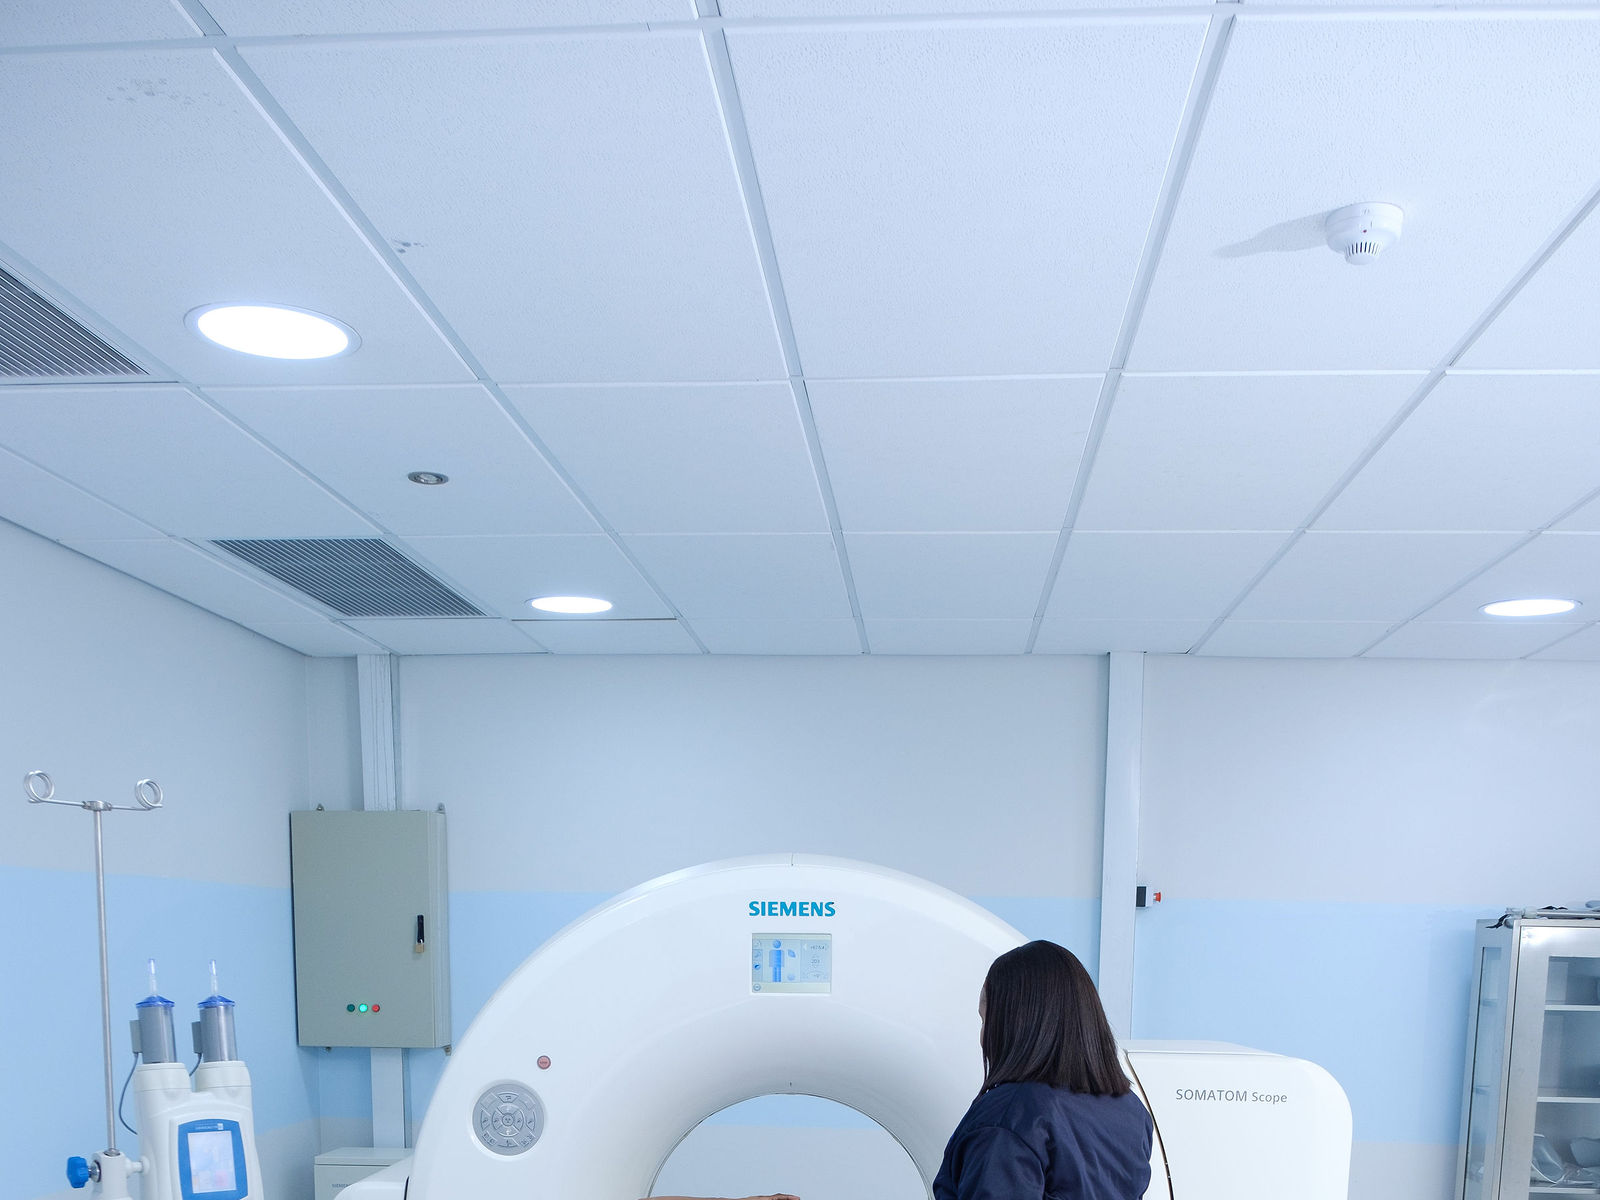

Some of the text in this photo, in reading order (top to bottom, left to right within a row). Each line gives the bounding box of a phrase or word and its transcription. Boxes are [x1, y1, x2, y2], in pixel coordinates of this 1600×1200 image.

[748, 901, 836, 917] SIEMENS
[1175, 1088, 1288, 1105] SOMATOM Scope
